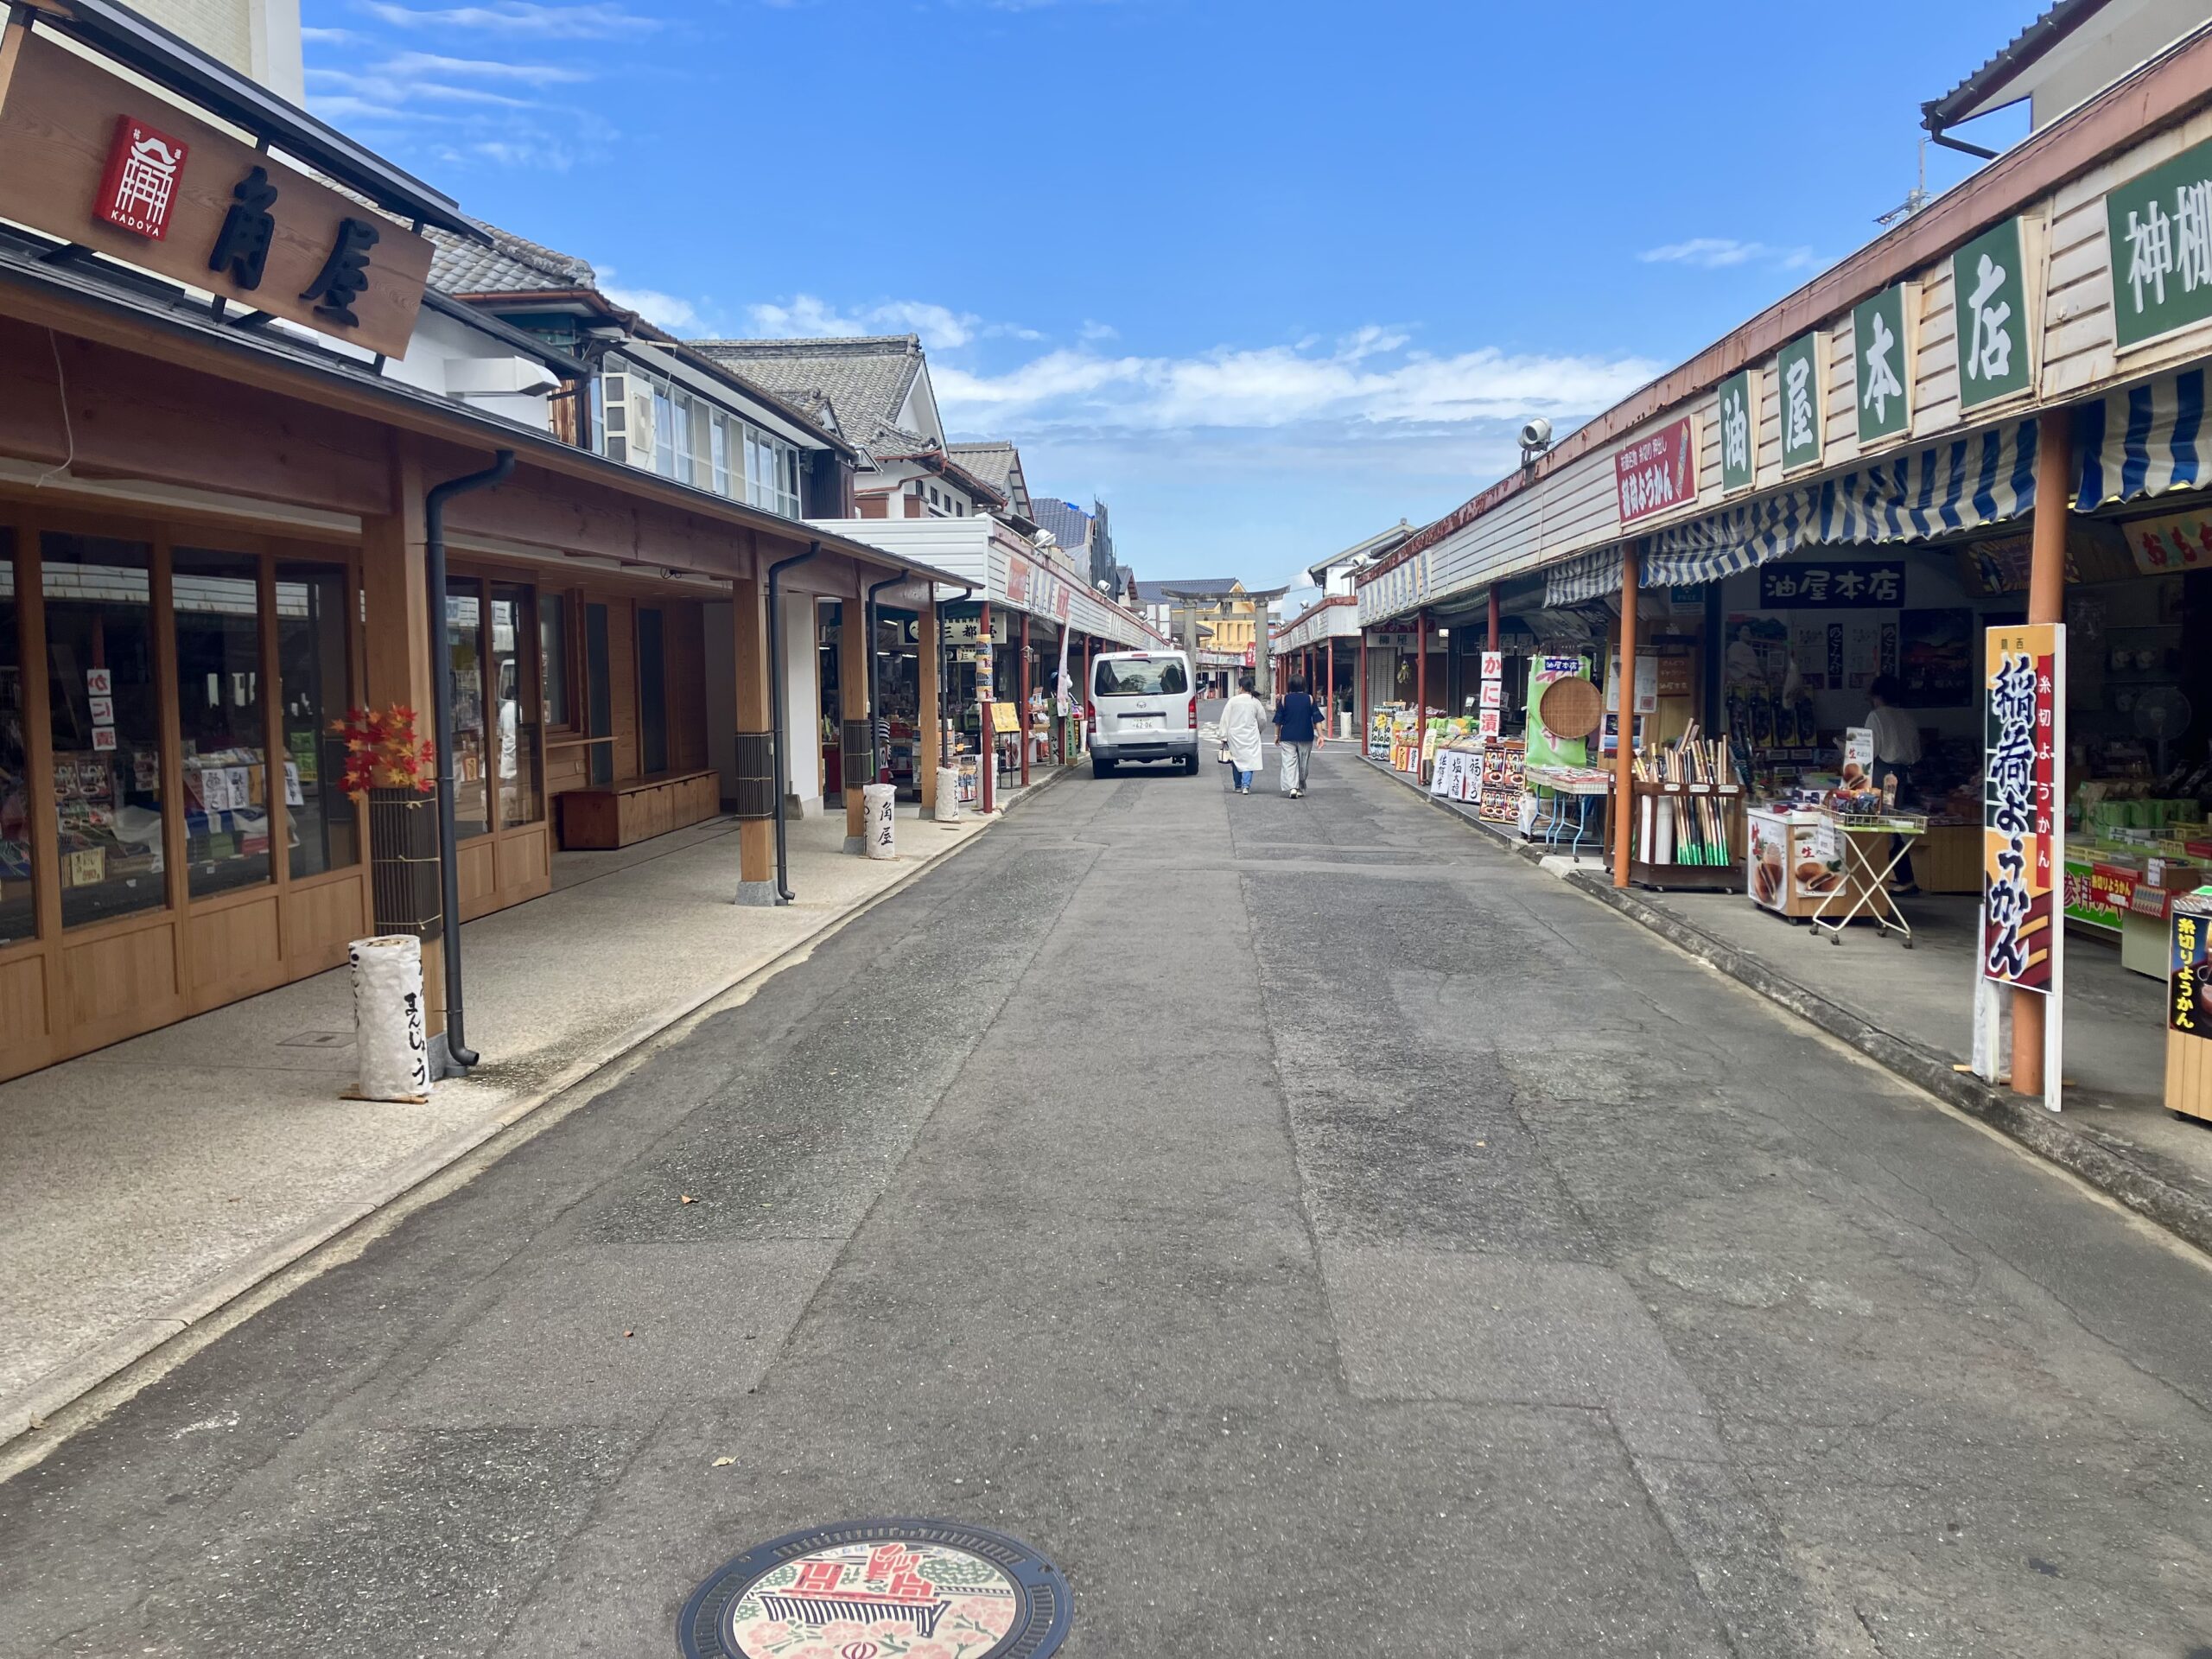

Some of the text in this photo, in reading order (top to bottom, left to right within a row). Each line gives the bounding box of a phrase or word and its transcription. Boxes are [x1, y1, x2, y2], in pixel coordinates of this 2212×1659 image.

[111, 209, 159, 237] KADOYA
[1621, 459, 1674, 518] 稲荷ようかん
[1764, 569, 1901, 601] 油屋本店
[1546, 660, 1578, 670] 油屋本店
[1481, 657, 1501, 733] かに漬
[1437, 753, 1447, 790] 佐賀牛
[1452, 757, 1462, 797] 塩大福
[2038, 675, 2051, 869] 糸切ようかん
[878, 801, 893, 846] 角屋
[1992, 655, 2037, 980] 稲荷ようかん
[2091, 874, 2132, 897] 糸切りようかん
[2177, 917, 2197, 1029] 糸切りようかん
